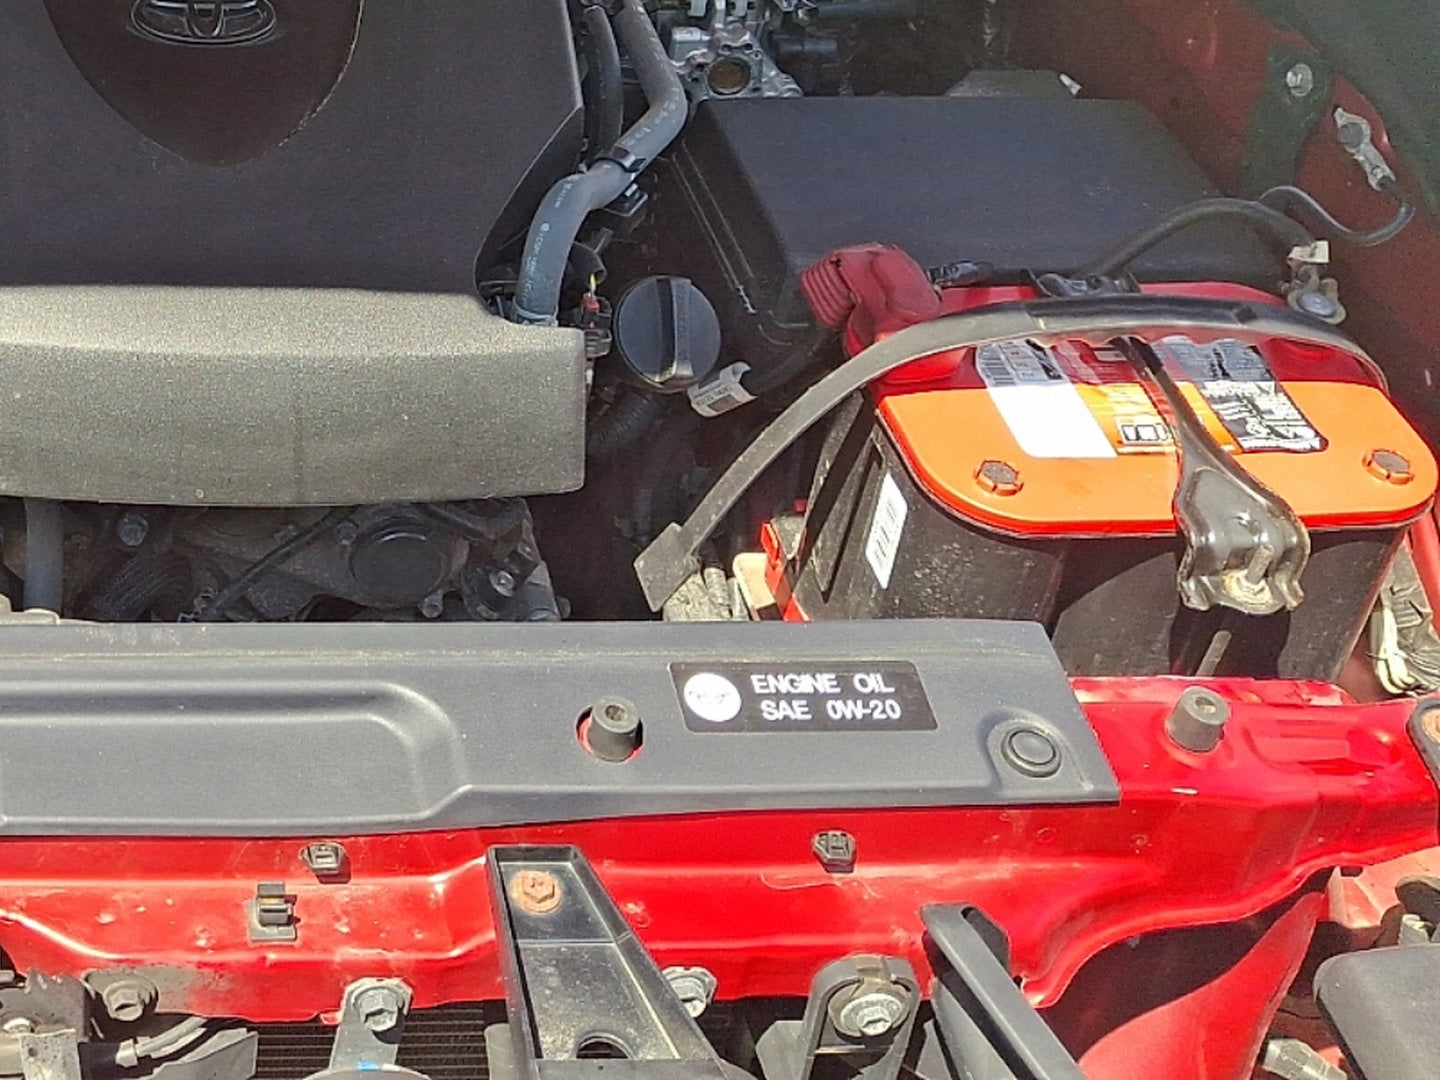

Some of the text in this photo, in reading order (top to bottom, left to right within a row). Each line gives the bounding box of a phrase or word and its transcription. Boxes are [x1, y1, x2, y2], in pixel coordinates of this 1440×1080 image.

[750, 672, 895, 694] ENGINE OIL
[761, 699, 902, 720] SAE 0W-20
